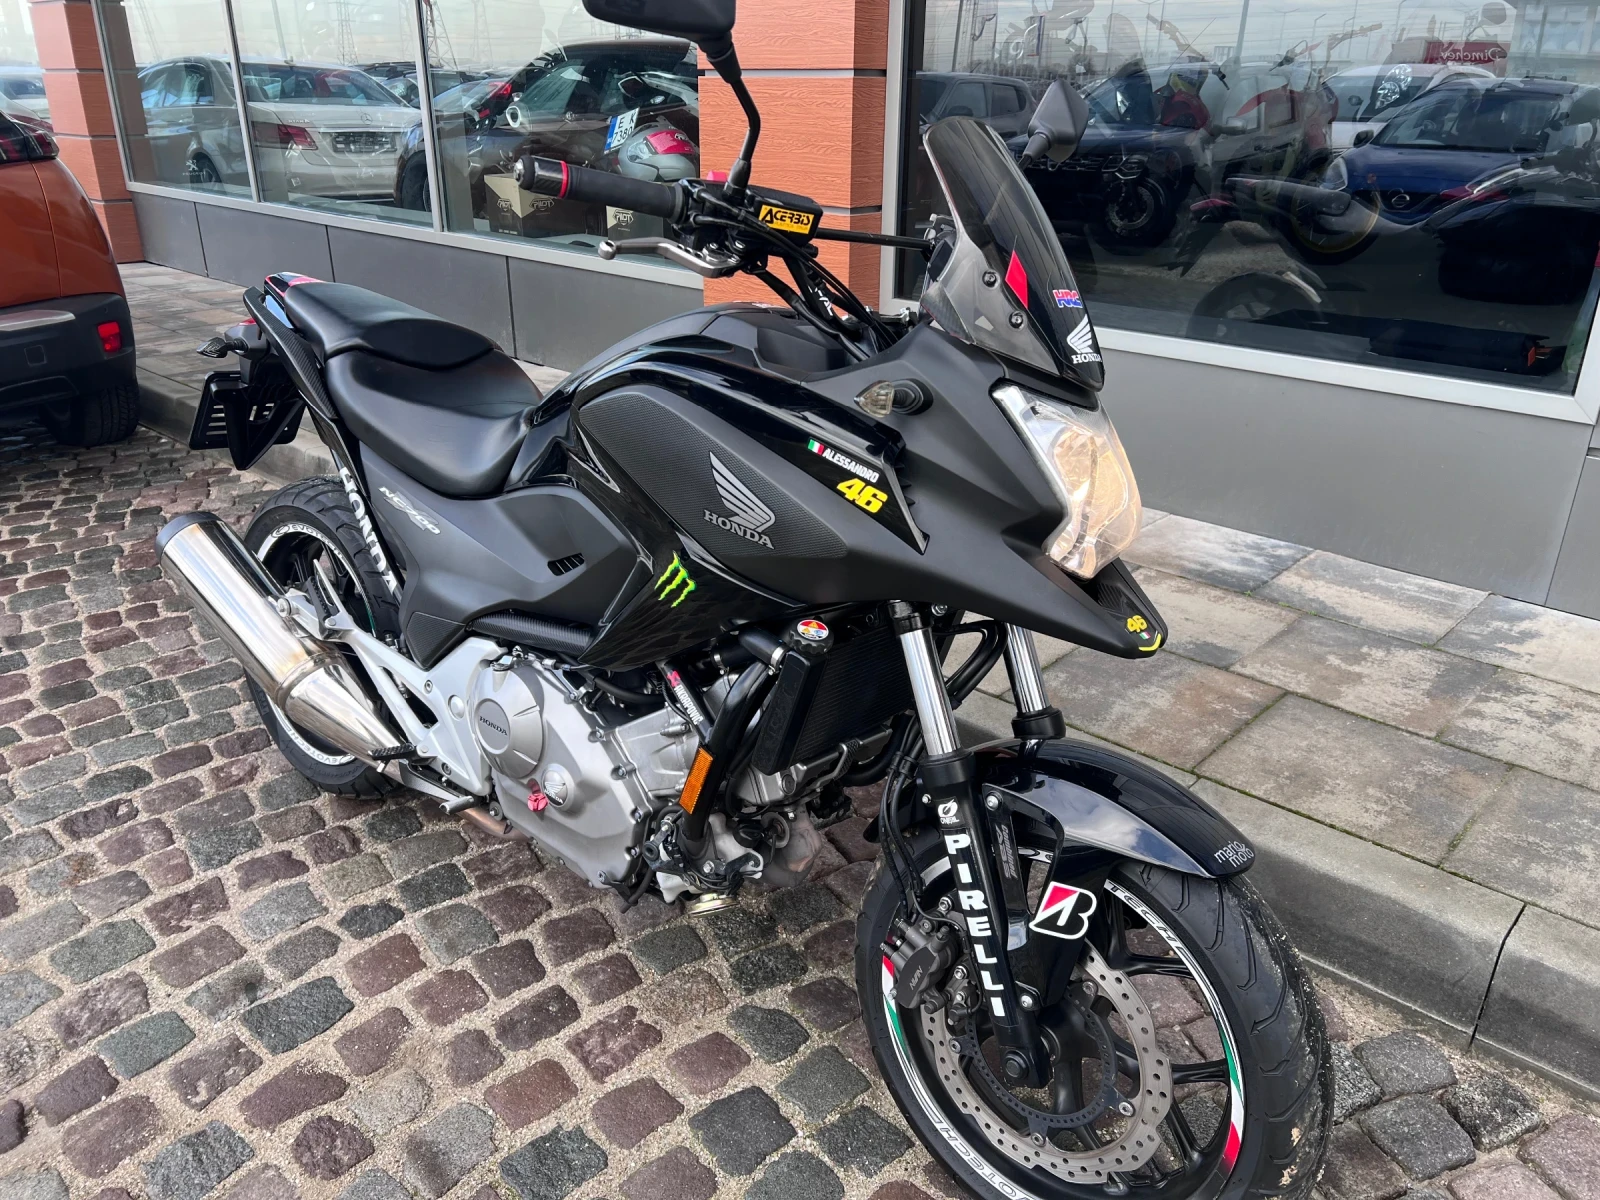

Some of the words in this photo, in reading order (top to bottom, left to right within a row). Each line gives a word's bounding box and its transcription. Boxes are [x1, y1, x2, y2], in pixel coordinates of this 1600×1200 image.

[618, 116, 626, 129] E
[1053, 290, 1083, 308] HRC
[822, 448, 880, 483] ALESSANDRO
[836, 477, 888, 514] 46
[340, 466, 397, 595] HONDA
[703, 508, 775, 550] HONDA
[479, 715, 509, 737] HONDA
[543, 789, 564, 805] HONDA
[1214, 841, 1244, 864] mario
[1228, 847, 1255, 868] moto
[944, 833, 1006, 1017] PIRELLI
